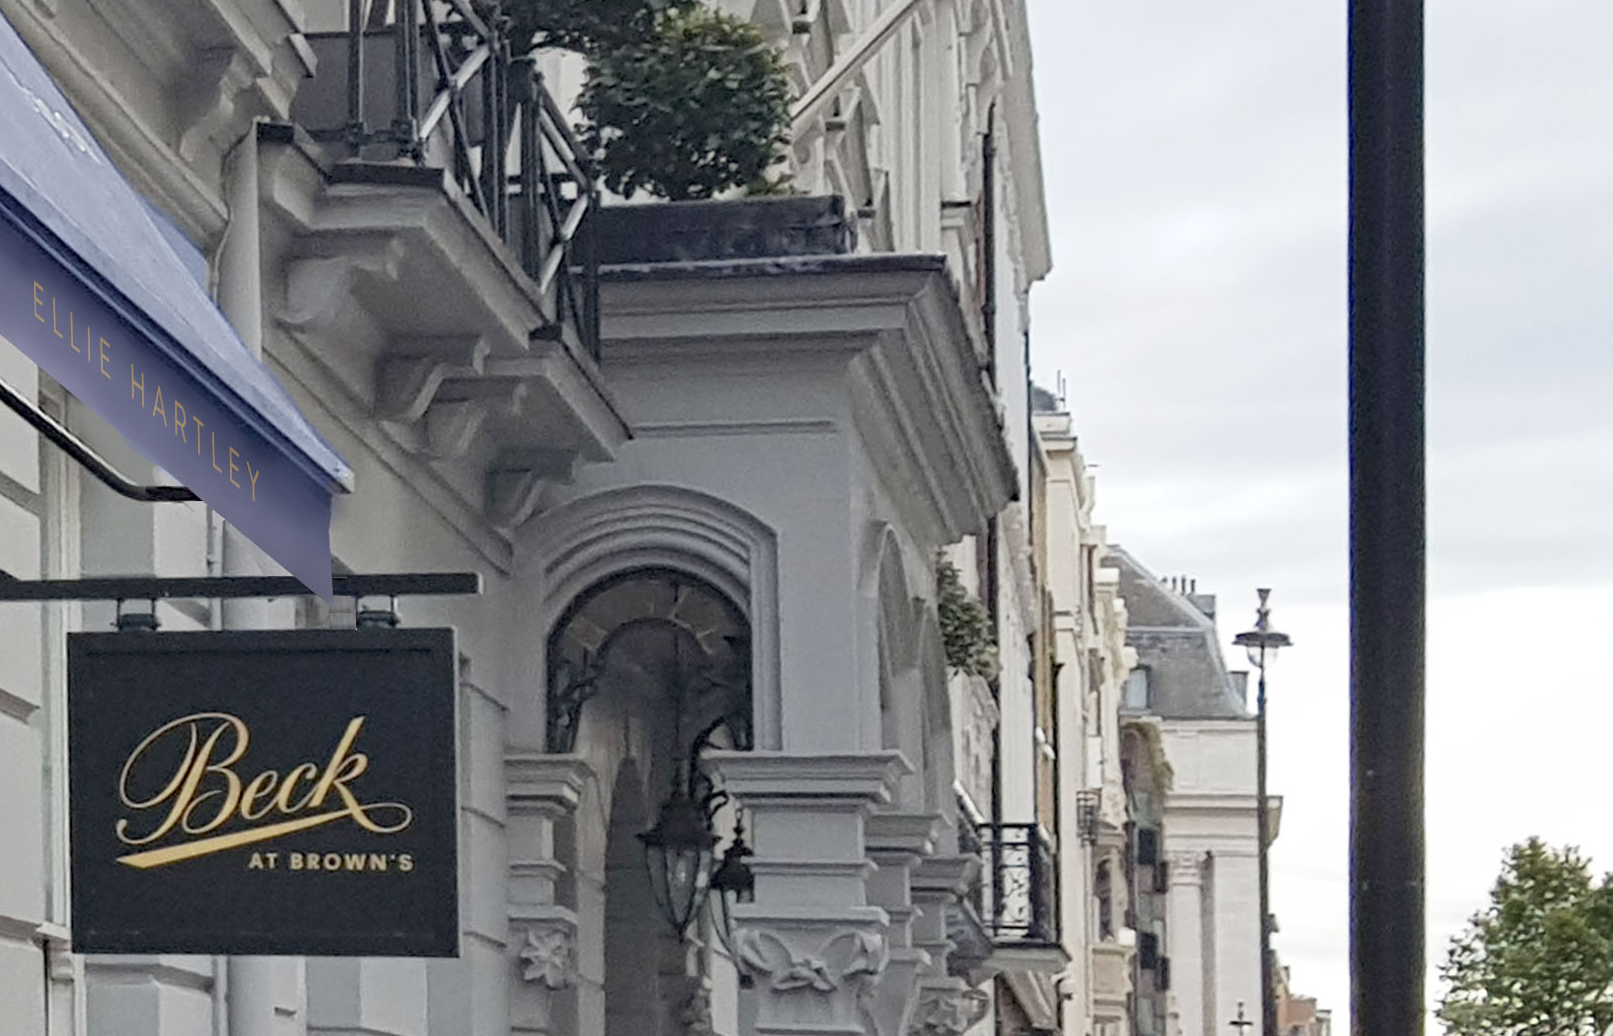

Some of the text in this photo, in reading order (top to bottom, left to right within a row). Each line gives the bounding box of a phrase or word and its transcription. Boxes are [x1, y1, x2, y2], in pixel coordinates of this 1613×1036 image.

[33, 280, 261, 502] ELLIE HARTLEY
[116, 711, 413, 869] Beck
[248, 851, 414, 872] AT BROWN'S
